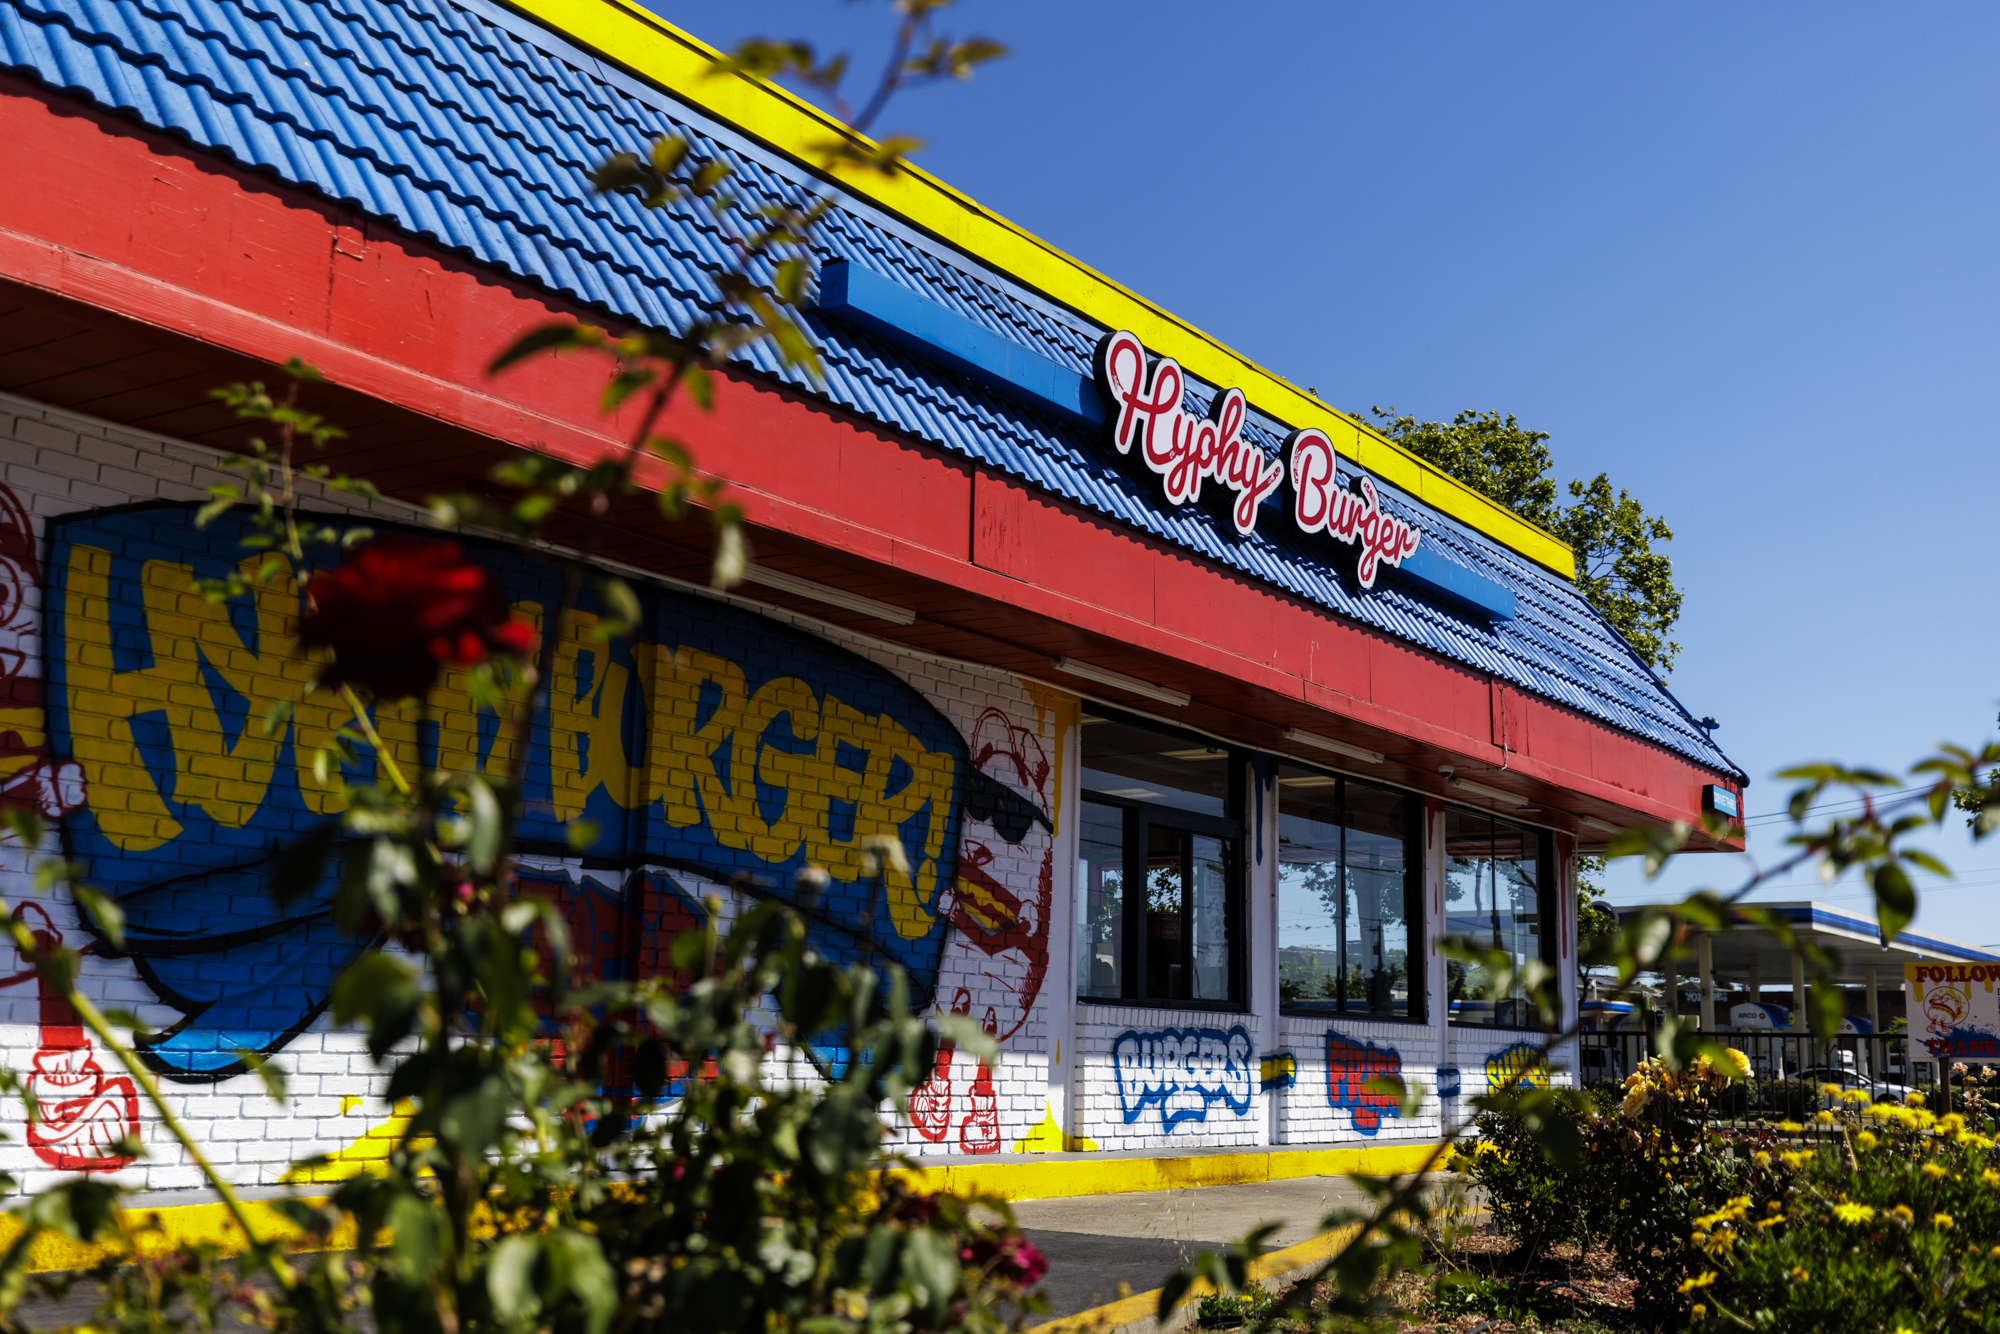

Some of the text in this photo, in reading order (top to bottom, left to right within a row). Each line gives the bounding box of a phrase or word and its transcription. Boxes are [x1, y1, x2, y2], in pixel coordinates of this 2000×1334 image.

[1107, 332, 1420, 586] Hyphy Burger
[1915, 965, 2000, 983] FOLLOW
[1113, 1026, 1254, 1134] BURGERS
[1325, 1030, 1405, 1134] FRIES
[1926, 1039, 2000, 1055] THANK
